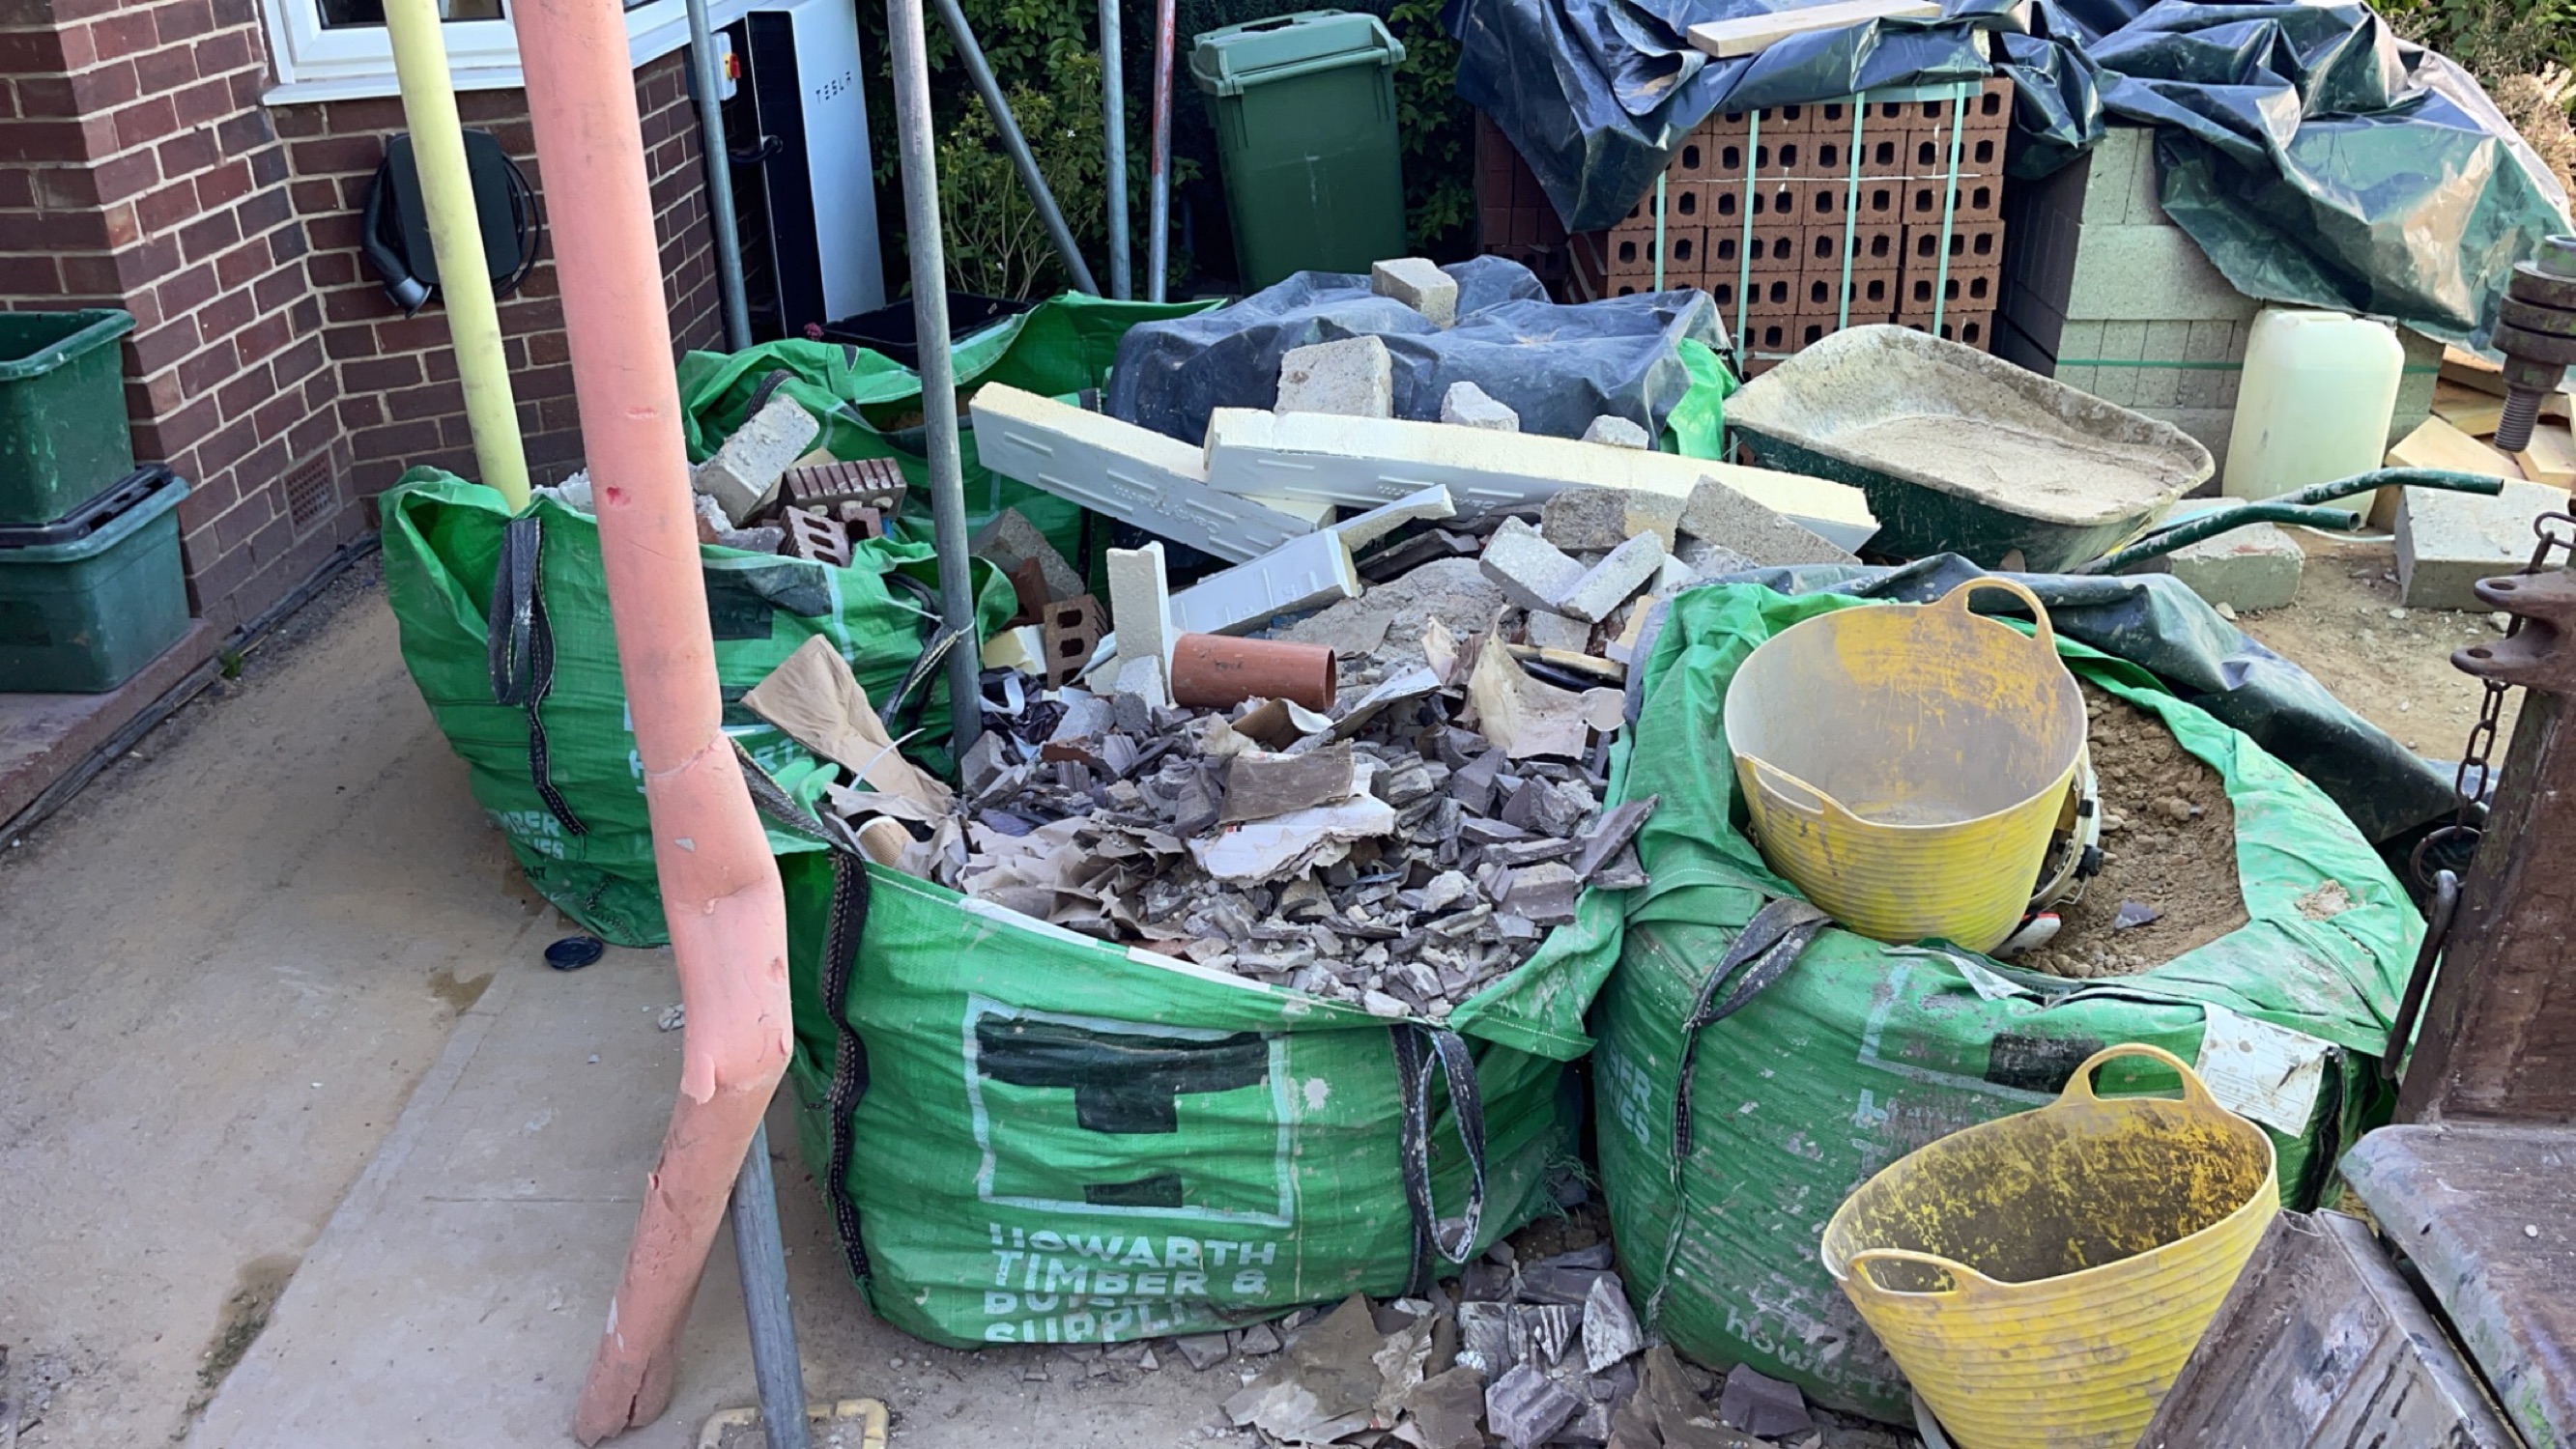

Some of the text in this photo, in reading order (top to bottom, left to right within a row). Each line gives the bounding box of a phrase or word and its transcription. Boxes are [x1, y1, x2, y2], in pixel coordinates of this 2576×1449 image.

[816, 71, 851, 105] TESLA
[989, 1222, 1276, 1268] HOWARTH
[991, 1249, 1268, 1294] TIMBER &
